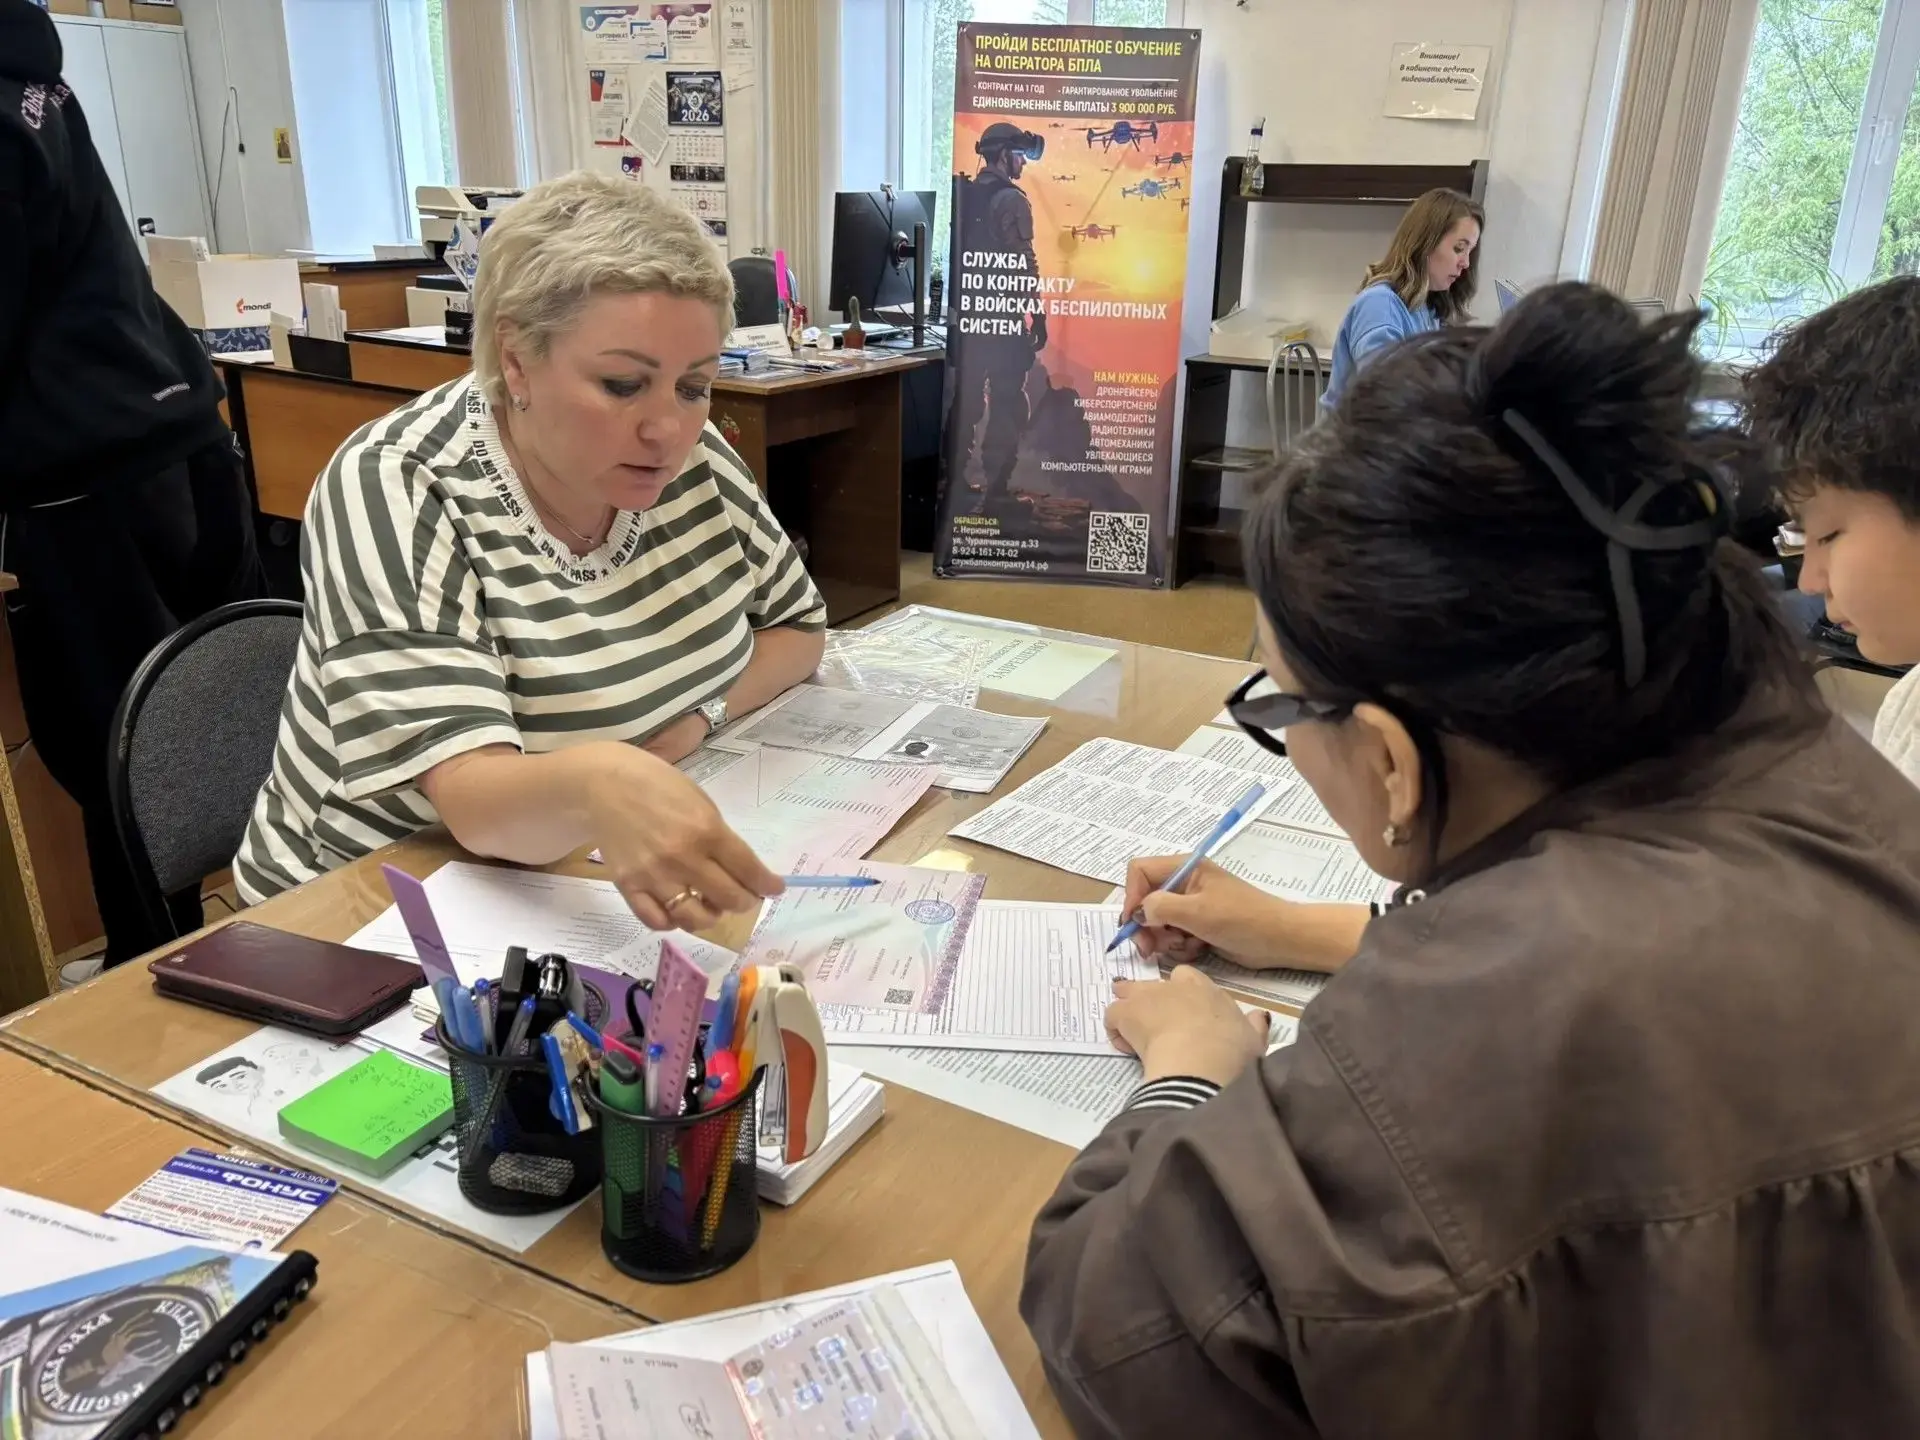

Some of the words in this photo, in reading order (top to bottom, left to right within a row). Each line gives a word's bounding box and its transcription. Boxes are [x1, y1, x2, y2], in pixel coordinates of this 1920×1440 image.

[975, 33, 1028, 52] ПРОЙДИ
[1032, 37, 1112, 55] БЕСПЛАТНОЕ
[1115, 40, 1181, 56] ОБУЧЕНИЕ
[1419, 52, 1460, 60] Внимание!
[975, 54, 991, 68] НА
[995, 55, 1065, 72] ОПЕРАТОРА
[1068, 58, 1102, 73] БПЛА
[1406, 64, 1442, 72] кабинете
[1401, 75, 1468, 84] видеонаблюдение.
[977, 81, 1013, 92] КОНТРАКТ
[1014, 84, 1024, 93] НА
[1030, 84, 1045, 94] ГОД
[1061, 86, 1129, 97] ГАРАНТИРОВАННОЕ
[1130, 88, 1178, 98] УВОЛЬНЕНИЕ
[973, 96, 1062, 110] ЕДИНОВРЕМЕННЫЕ
[1063, 100, 1110, 113] ВЫПЛАТЫ
[1111, 103, 1117, 113] 3
[1119, 102, 1135, 113] 900
[1137, 103, 1154, 114] 000
[1157, 103, 1177, 115] РУБ.
[681, 109, 710, 122] 2026
[963, 251, 1028, 270] СЛУЖБА
[961, 273, 983, 289] ПО
[987, 275, 1075, 293] КОНТРАКТУ
[243, 302, 271, 311] mondi
[961, 295, 970, 311] В
[974, 293, 1046, 315] ВОЙСКАХ
[1050, 299, 1167, 320] БЕСПИЛОТНЫХ
[959, 317, 1022, 336] СИСТЕМ
[1094, 371, 1115, 383] НАМ
[1118, 372, 1159, 384] НУЖНЫ:
[1096, 386, 1158, 397] ДРОНРЕЙСЕРЫ
[1074, 398, 1157, 411] КИБЕРСПОРТСМЕНЫ
[1083, 411, 1156, 424] АВИАМОДЕЛИСТЫ
[1091, 425, 1155, 437] РАДИОТЕХНИКИ
[1090, 438, 1154, 449] АВТОМЕХАНИКИ
[1085, 450, 1153, 462] УВЛЕКАЮЩИЕСЯ
[1041, 461, 1117, 473] КОМПЬЮТЕРНЫМИ
[1119, 465, 1152, 475] ИГРАМИ
[472, 440, 488, 457] DO
[481, 460, 502, 482] NOT
[495, 484, 524, 518] PASS
[960, 526, 1000, 537] Нерюнгри
[952, 537, 963, 546] ул.
[965, 537, 1020, 547] Чурапчинская
[610, 553, 626, 568] DO
[625, 530, 638, 553] NOT
[952, 546, 1018, 558] 8-924-161-74-02
[540, 540, 555, 559] DO
[554, 557, 570, 574] NOT
[570, 568, 597, 582] PASS
[951, 558, 1049, 570] службапоконтракту14.рф
[290, 1171, 329, 1185] 40-900
[221, 1171, 322, 1202] ФОНУС
[58, 1312, 113, 1354] САХА
